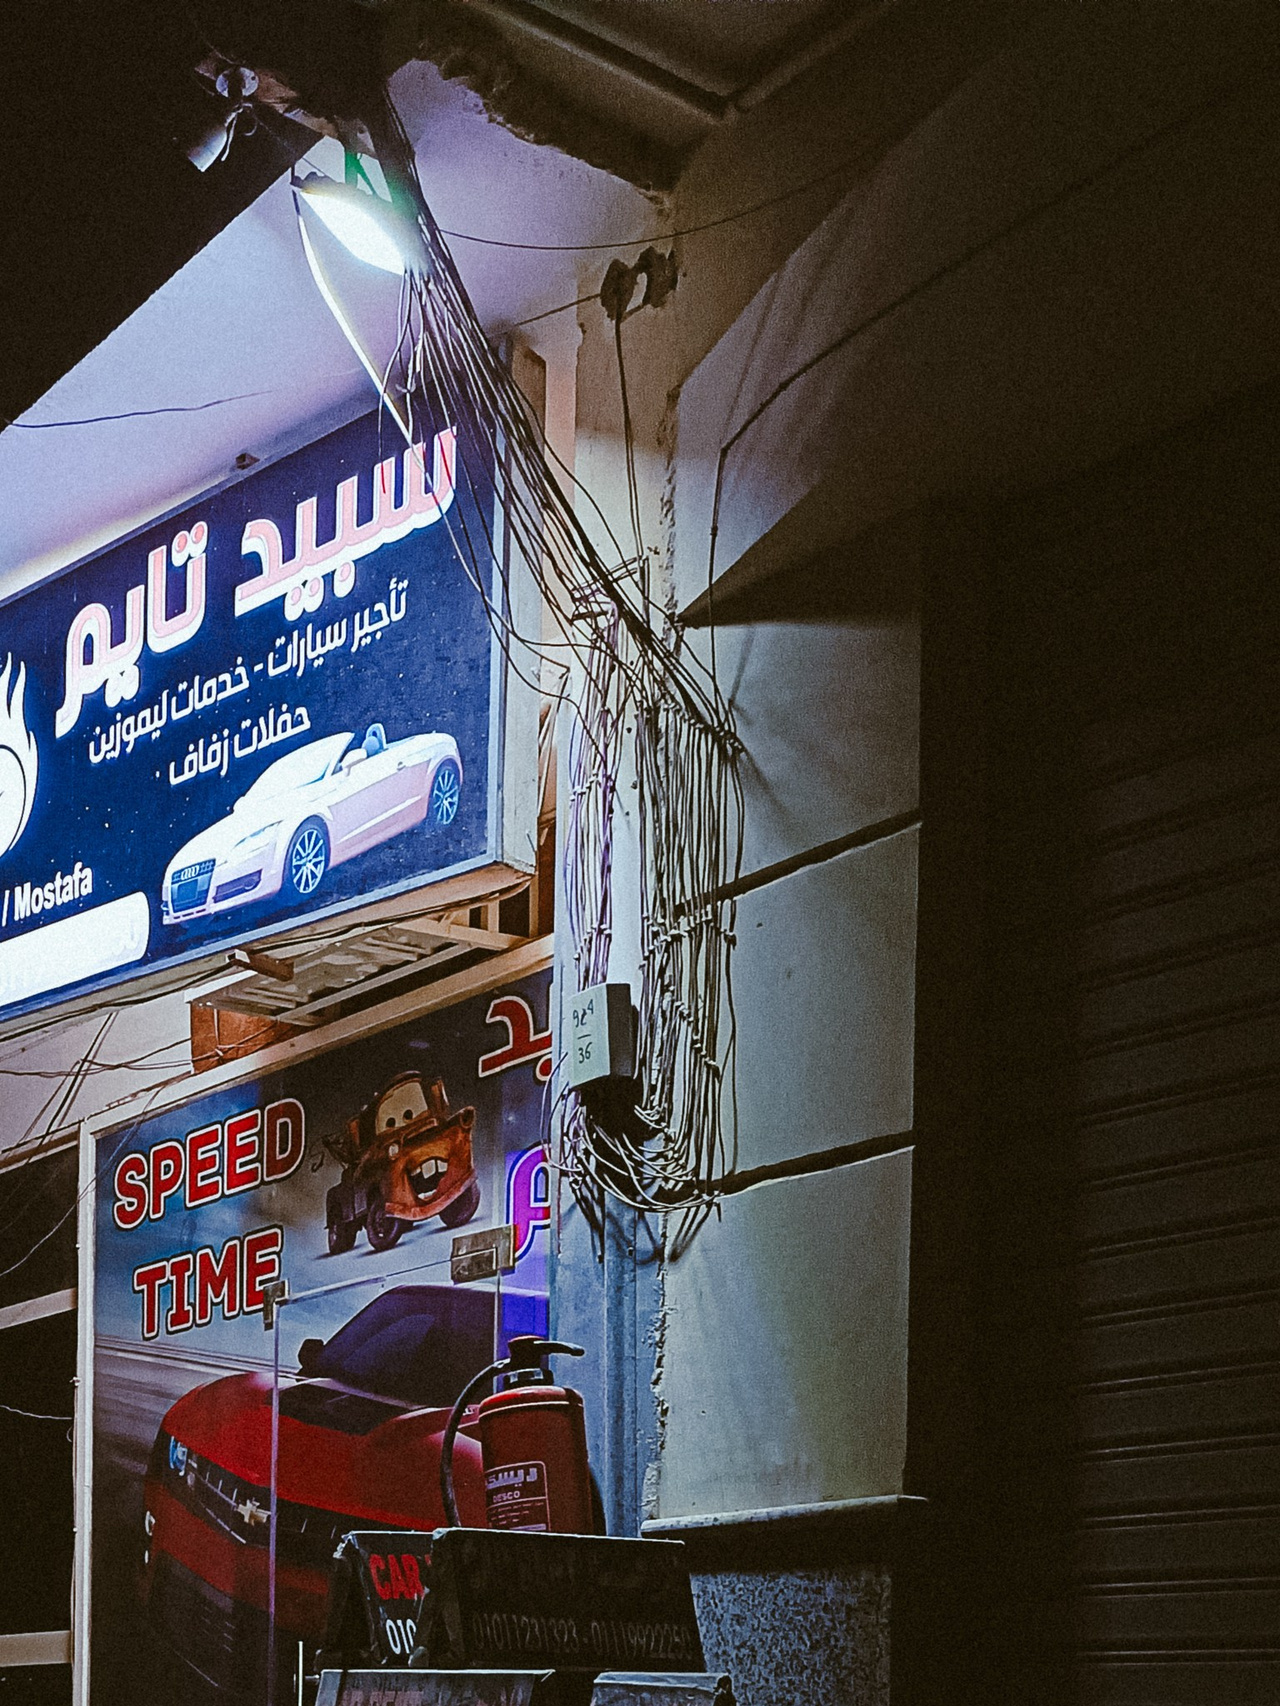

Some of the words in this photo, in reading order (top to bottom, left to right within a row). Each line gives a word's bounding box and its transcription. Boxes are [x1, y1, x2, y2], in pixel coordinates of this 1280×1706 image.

[235, 426, 458, 621] سبيد
[55, 521, 208, 739] تايم
[268, 618, 348, 677] سيارات
[352, 578, 409, 653] تأجير
[170, 656, 250, 721] خدمات
[88, 688, 170, 764] ليموزين
[169, 728, 230, 786] زفاف
[233, 703, 311, 760] حفلات
[14, 862, 94, 922] Mostafa
[112, 1097, 307, 1230] SPEED
[132, 1226, 284, 1340] TIME
[369, 1553, 425, 1600] CAR
